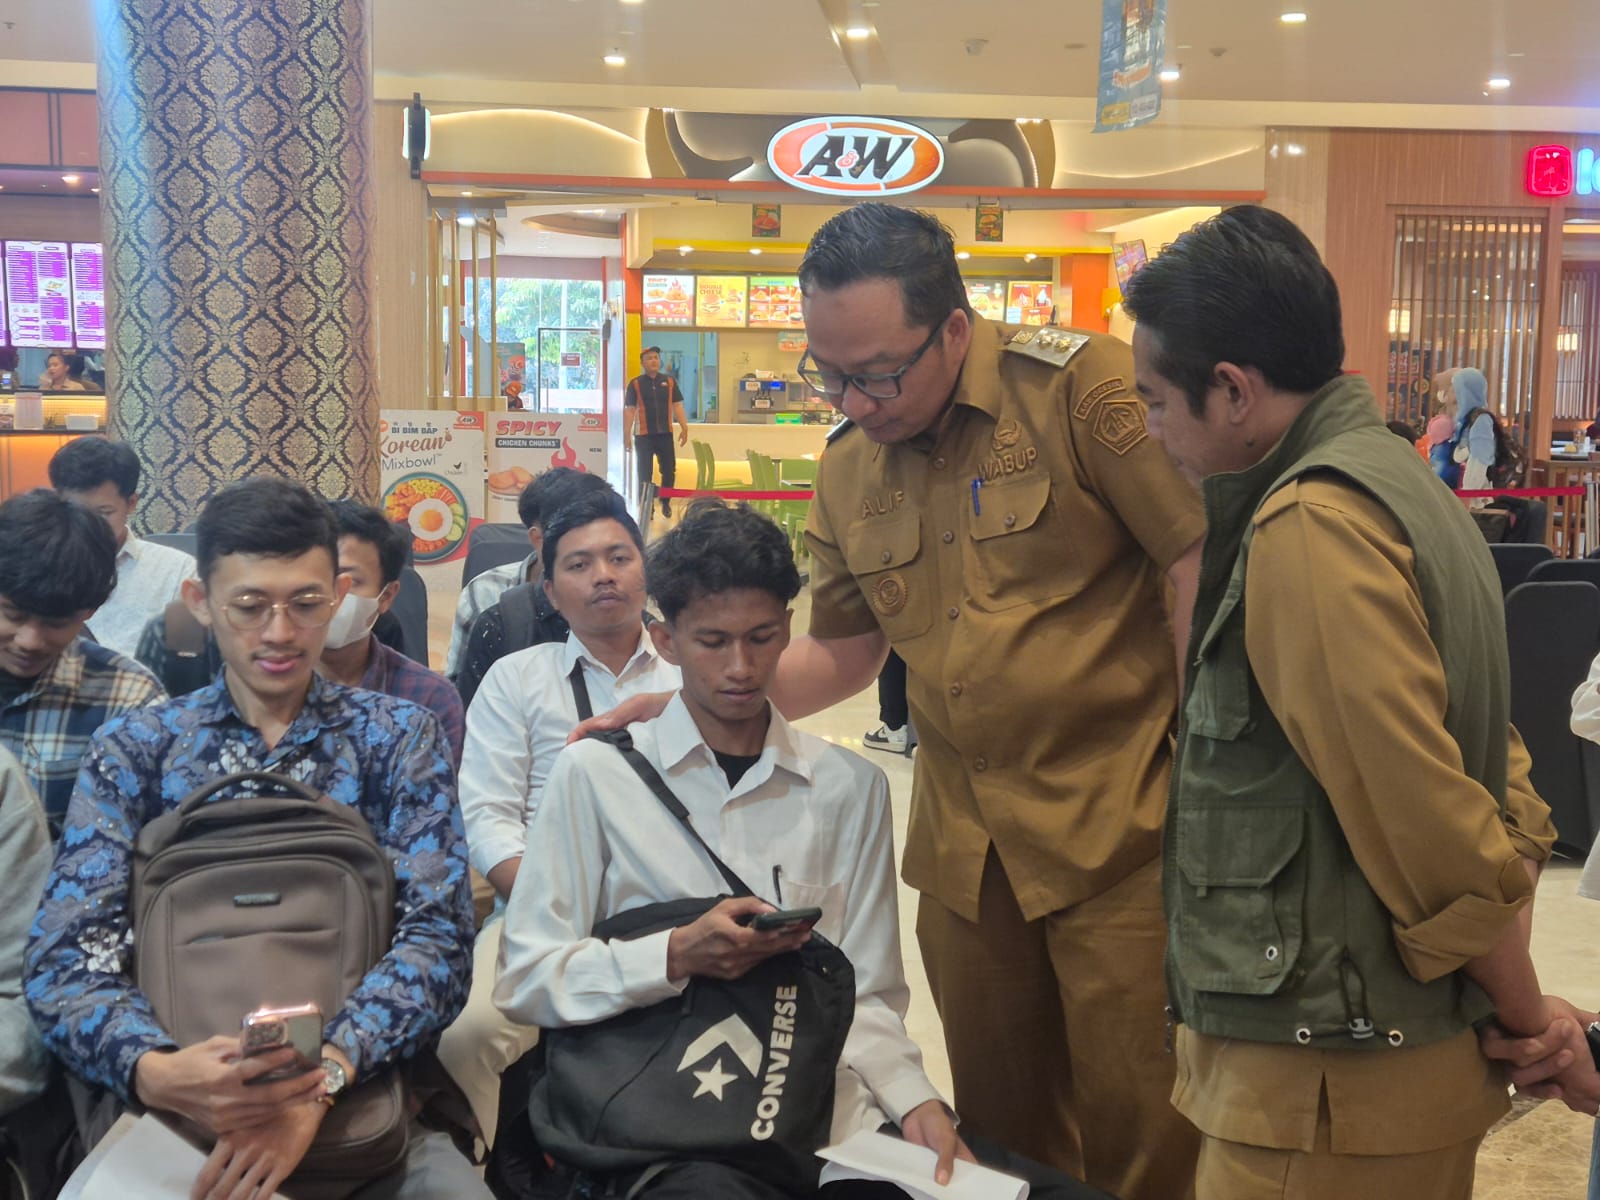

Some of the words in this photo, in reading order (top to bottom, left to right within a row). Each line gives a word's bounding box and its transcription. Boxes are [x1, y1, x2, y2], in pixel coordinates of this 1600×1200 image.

[796, 135, 915, 180] A&W
[495, 420, 562, 436] SPICY
[976, 447, 1038, 480] WABUP
[862, 489, 904, 520] ALIF
[750, 985, 798, 1141] CONVERSE
